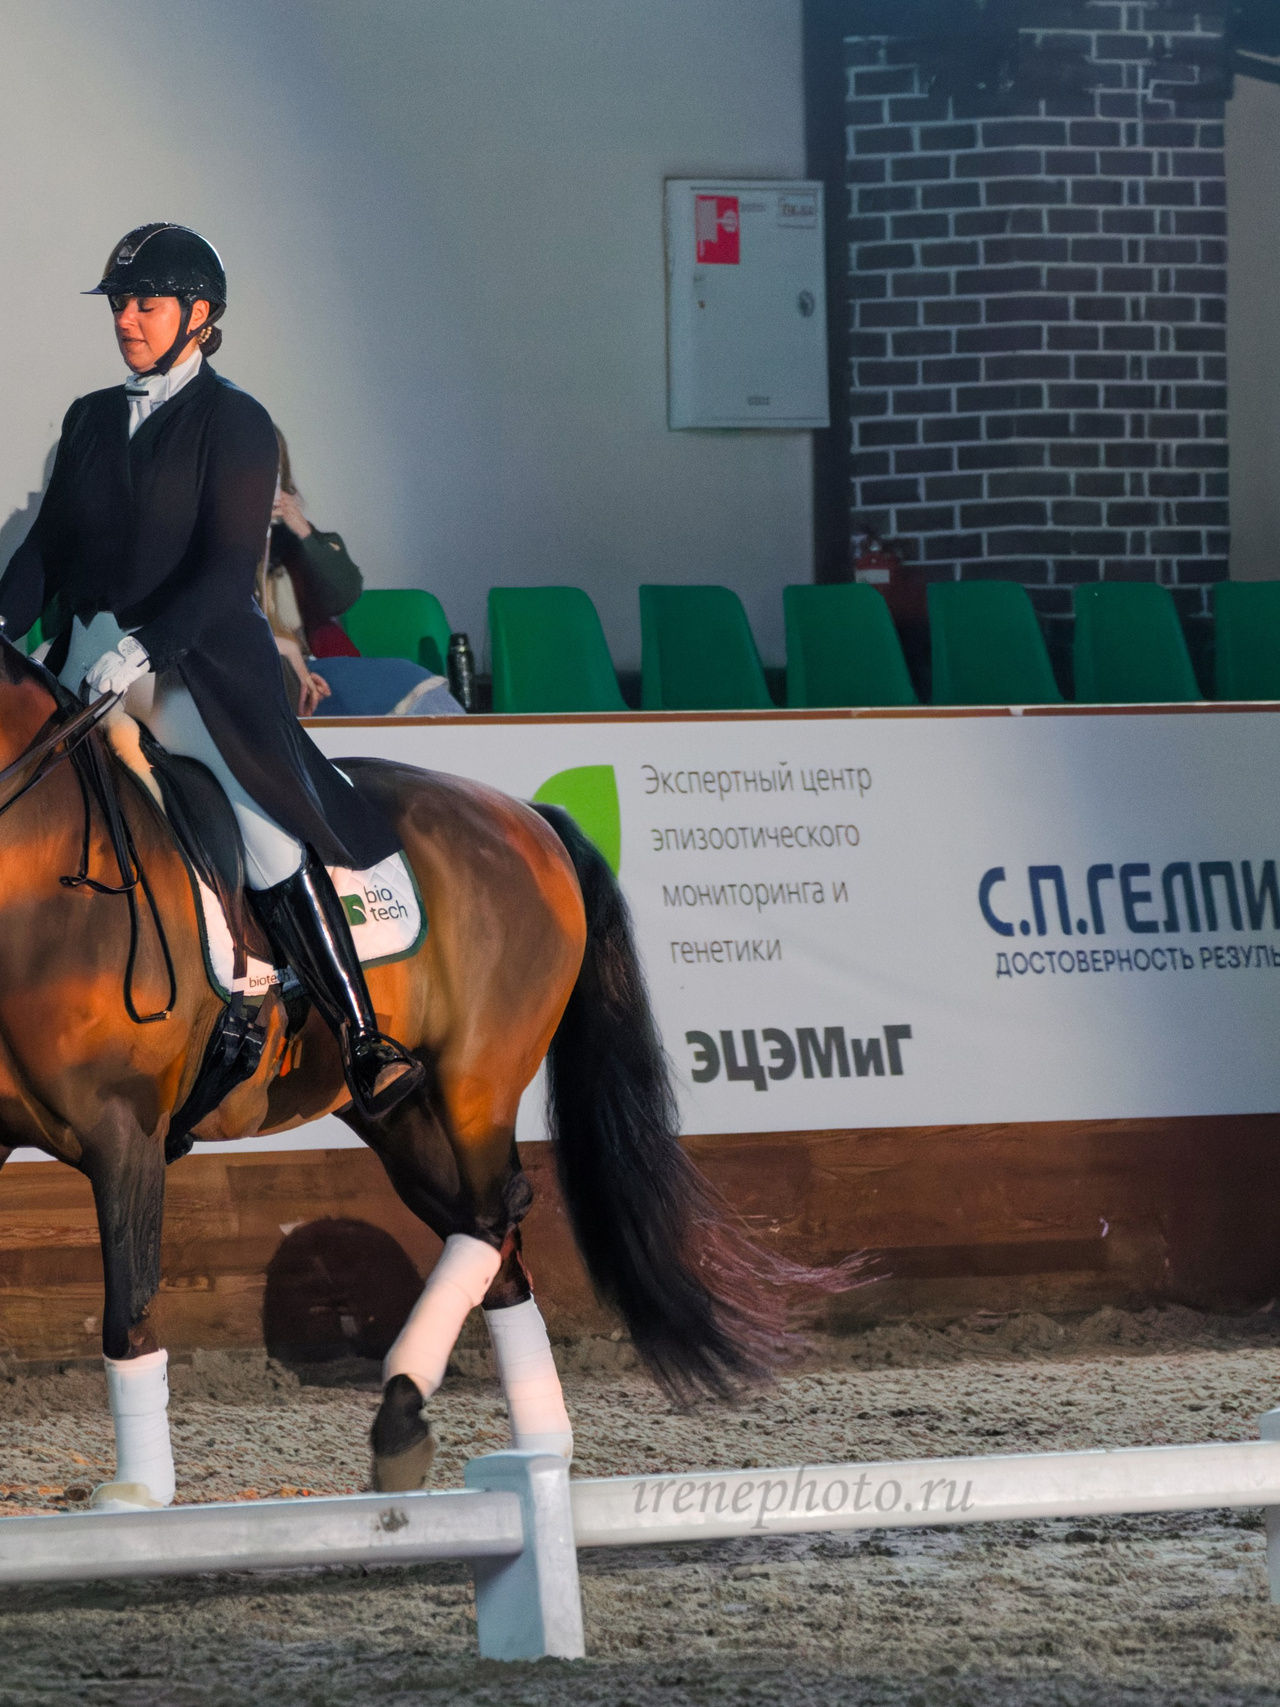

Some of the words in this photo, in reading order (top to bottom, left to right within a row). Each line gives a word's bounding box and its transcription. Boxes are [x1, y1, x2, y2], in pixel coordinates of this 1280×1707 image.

[641, 761, 794, 801] Экспертный
[800, 768, 872, 798] центр
[651, 825, 860, 851] эпизоотического
[363, 884, 393, 904] bio
[662, 882, 825, 914] мониторинга
[832, 881, 849, 903] и
[370, 900, 408, 921] tech
[670, 939, 783, 963] генетики
[995, 947, 1195, 979] ДОСТОВЕРНОСТЬ
[685, 1023, 913, 1091] ЭЦЭМиГ
